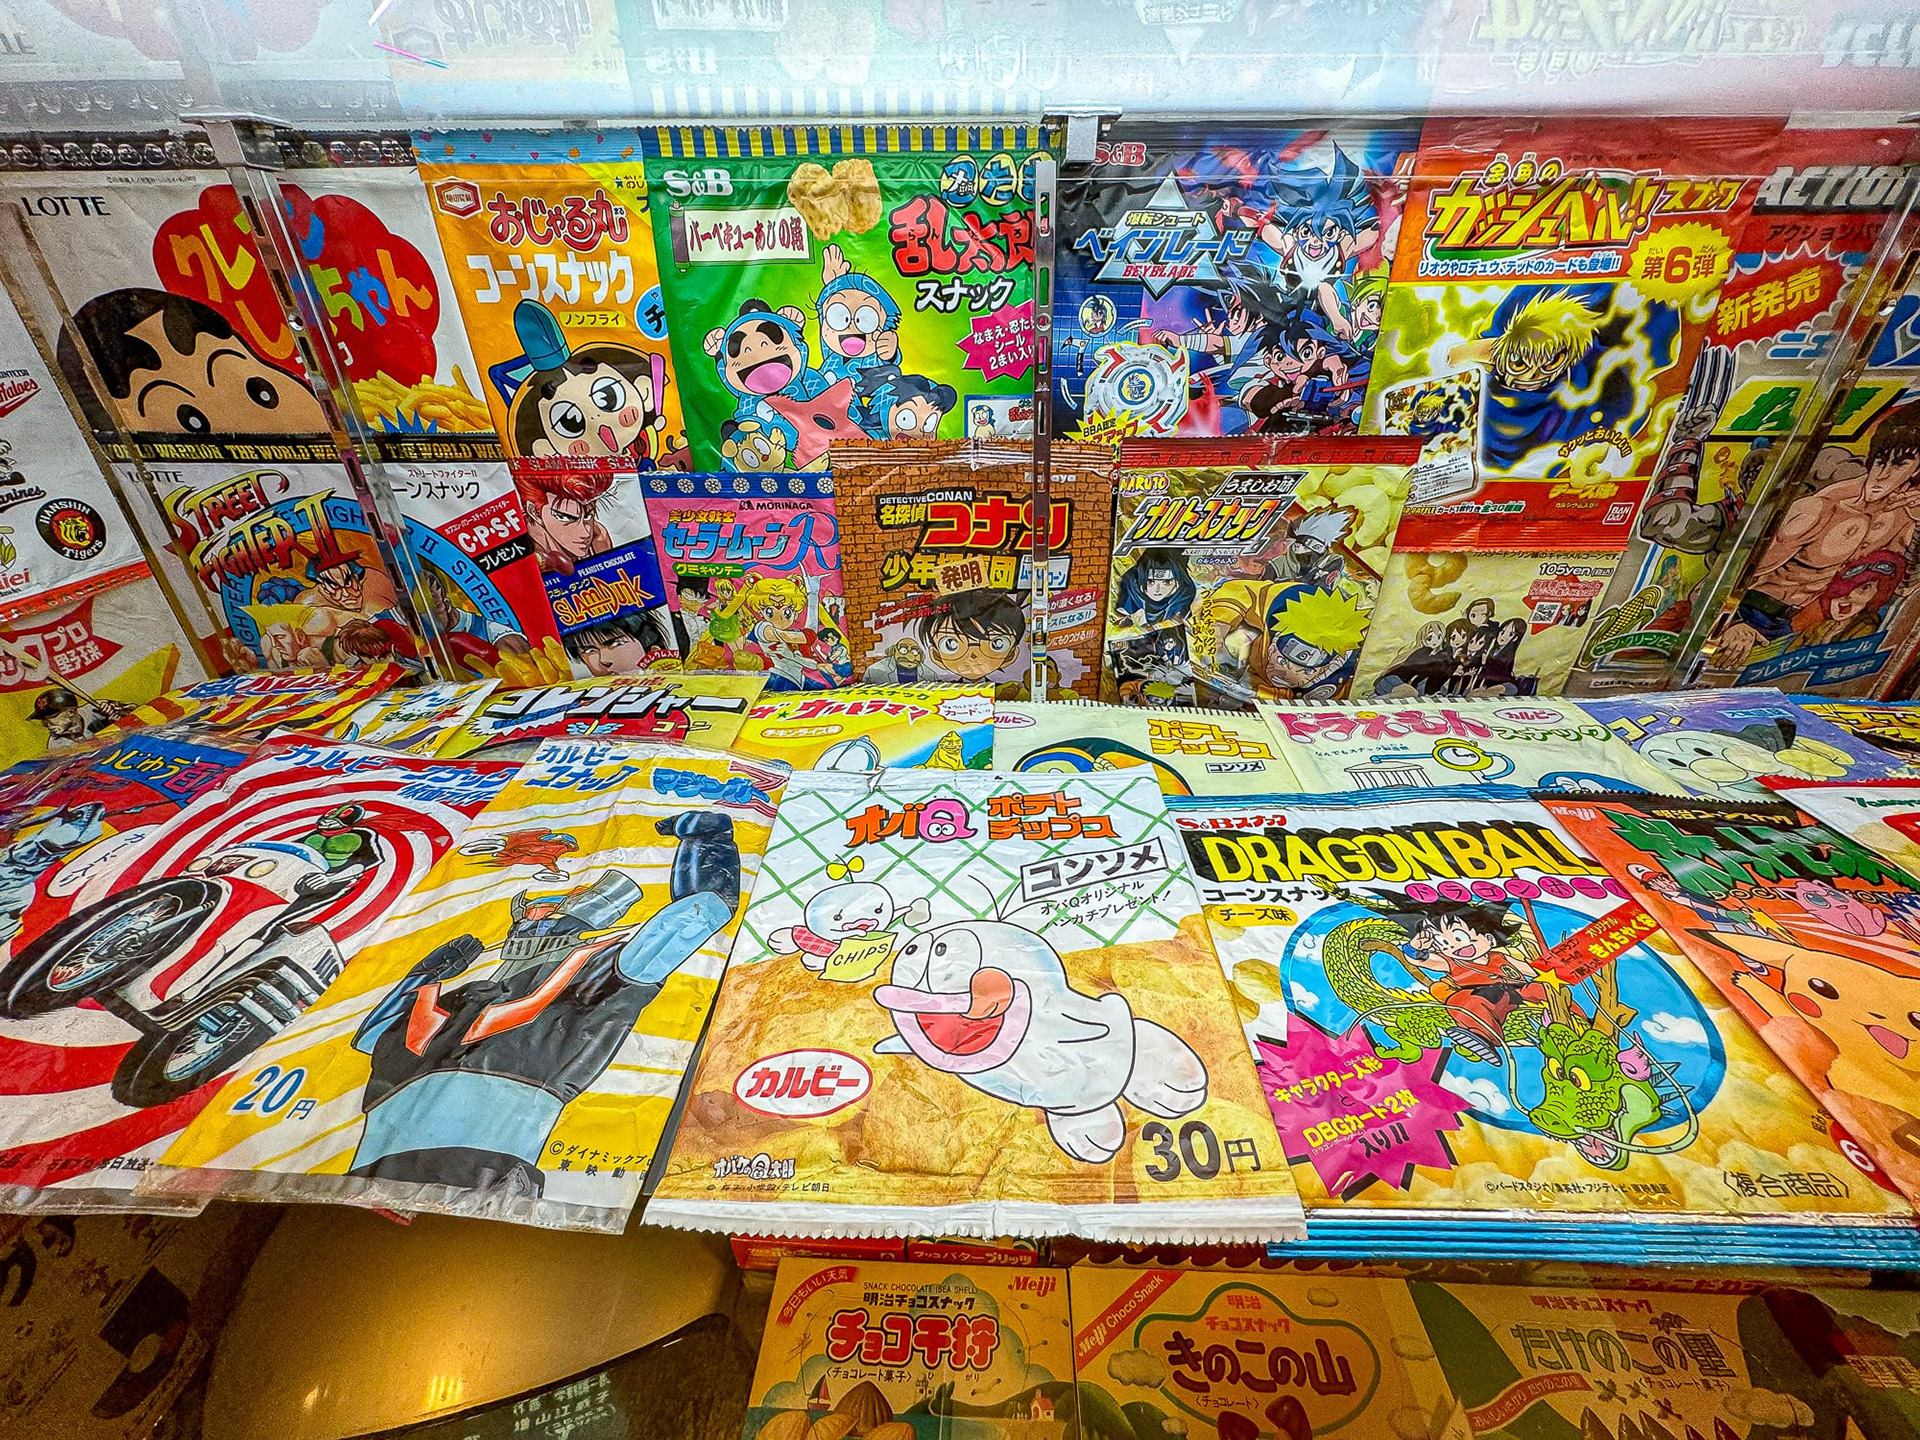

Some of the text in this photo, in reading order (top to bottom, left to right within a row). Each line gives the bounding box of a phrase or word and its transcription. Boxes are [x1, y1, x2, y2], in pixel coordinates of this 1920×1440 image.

[663, 168, 735, 196] S&B
[21, 196, 111, 217] LOTTE
[488, 190, 629, 247] おじゃる丸
[1074, 228, 1254, 264] ベイブレード
[466, 251, 635, 305] コーンスナック
[1122, 264, 1198, 278] BEYBLADE
[1643, 248, 1716, 284] 第6弾
[917, 279, 1015, 311] スナック
[1717, 265, 1821, 335] 新発売
[565, 313, 621, 326] ノンフライ
[994, 334, 1025, 353] シール
[256, 444, 310, 459] WORLD
[392, 481, 480, 500] ーンスナック
[1120, 475, 1169, 493] NARUTO
[756, 502, 814, 510] MORINAGA
[880, 491, 973, 505] DETECTIVE CONAN
[40, 501, 91, 525] HANSHIN
[880, 504, 927, 526] 名探偵
[1135, 496, 1280, 540] ナルトスナック
[62, 540, 103, 559] Tigers
[662, 523, 789, 560] セーラームーン
[479, 542, 526, 571] プレゼント
[604, 551, 637, 570] CHOCOLATE
[941, 560, 983, 588] 発明
[53, 640, 104, 675] 野球
[1275, 709, 1495, 745] ドラえもん
[1506, 708, 1561, 722] カルビー
[1147, 719, 1238, 741] ポテト
[1490, 723, 1613, 742] スナック
[537, 746, 632, 764] カルビー
[1150, 738, 1278, 761] チップス
[526, 766, 641, 791] スナック
[1208, 762, 1265, 773] コンソメ
[987, 790, 1083, 816] ポテト
[846, 798, 979, 846] オバQ
[987, 813, 1120, 841] チップス
[1028, 843, 1164, 892] コンソメ
[1040, 879, 1146, 915] オバQオリジナル
[1219, 906, 1292, 922] チーズ味
[832, 943, 890, 967] CHIPS
[747, 1065, 861, 1103] カルビー
[1274, 1057, 1383, 1104] キャラクター人形
[1339, 1093, 1355, 1107] と
[1302, 1089, 1420, 1148] DBGカード2枚
[863, 1281, 889, 1290] SNACK
[891, 1282, 934, 1293] CHOCOLATE
[1008, 1276, 1057, 1297] Meiji
[863, 1292, 976, 1311] 明治チョコスナック
[1106, 1297, 1137, 1330] Choco
[1134, 1273, 1165, 1305] Snack
[1226, 1295, 1262, 1310] 明治
[1205, 1317, 1292, 1334] チョコスナック
[1510, 1323, 1738, 1378] たけのこの里
[1163, 1330, 1358, 1397] きのこの山
